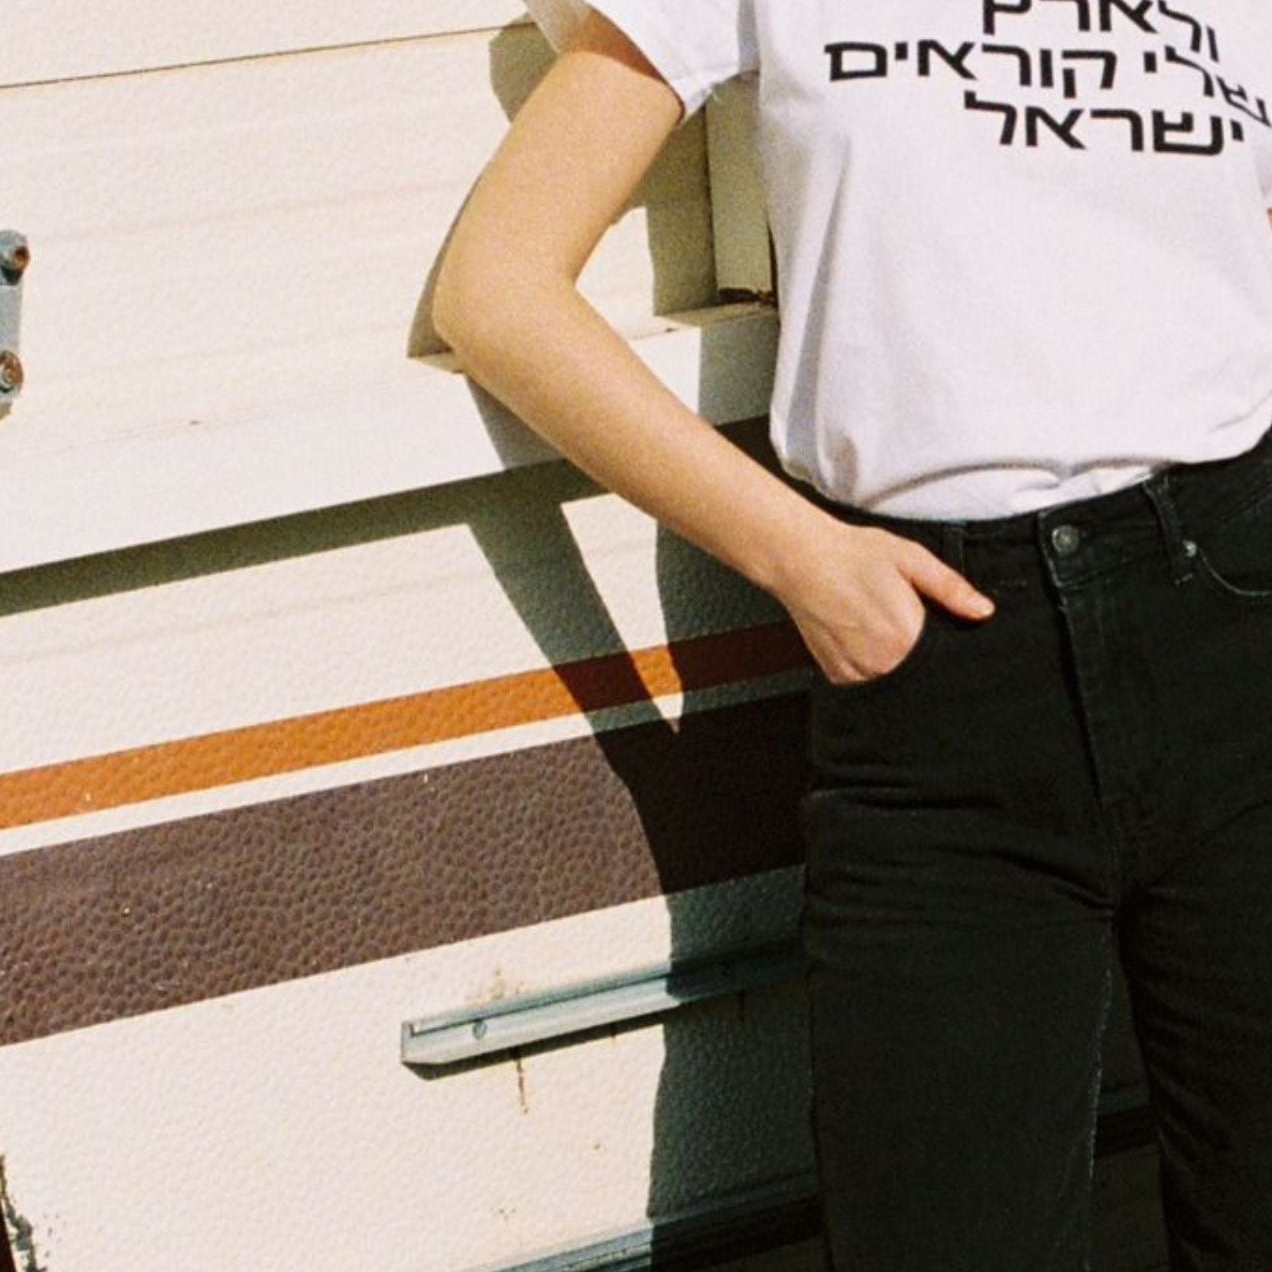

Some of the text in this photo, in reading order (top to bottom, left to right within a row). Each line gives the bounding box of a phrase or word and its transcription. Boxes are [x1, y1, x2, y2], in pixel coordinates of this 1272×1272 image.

[824, 39, 1272, 128] שלי קוראים
[964, 90, 1245, 157] ישראל
